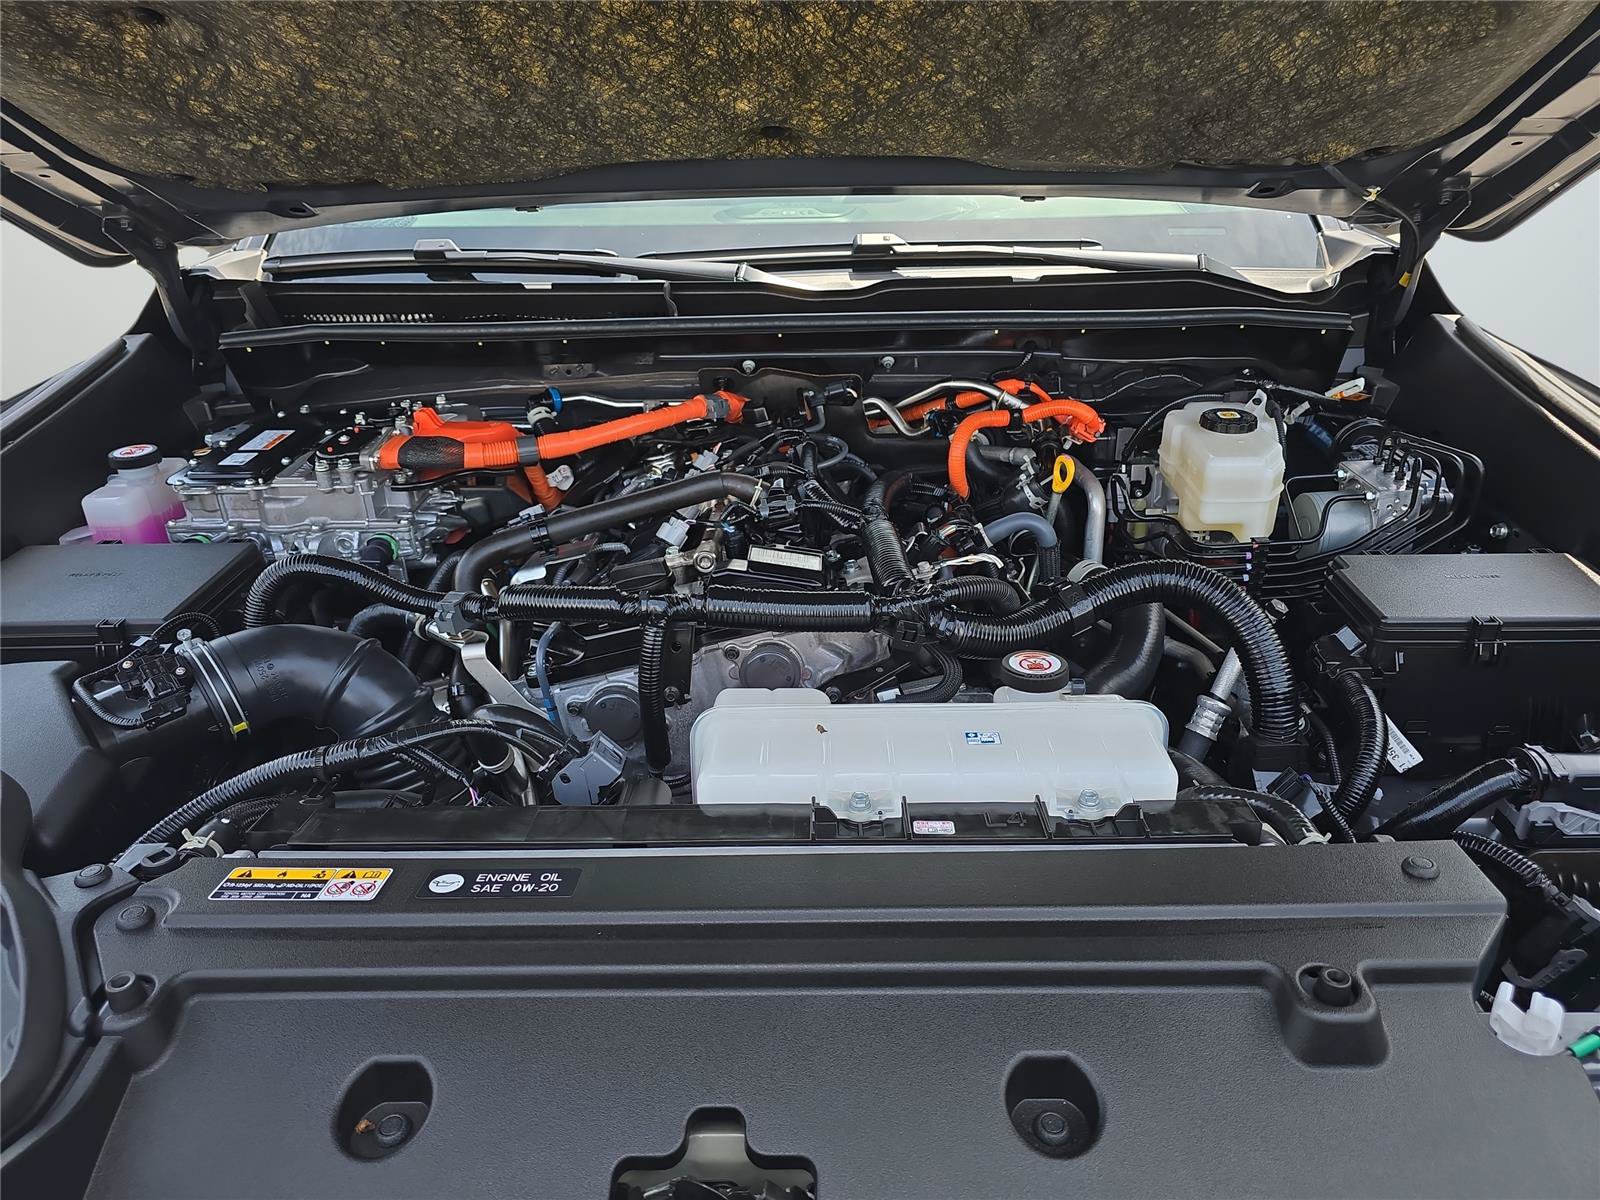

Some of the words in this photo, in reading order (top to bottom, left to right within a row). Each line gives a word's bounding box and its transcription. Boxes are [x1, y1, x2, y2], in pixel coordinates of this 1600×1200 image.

[475, 872, 531, 882] ENGINE
[540, 872, 563, 882] OIL
[470, 883, 503, 893] SAE
[511, 883, 559, 893] 0W-20
